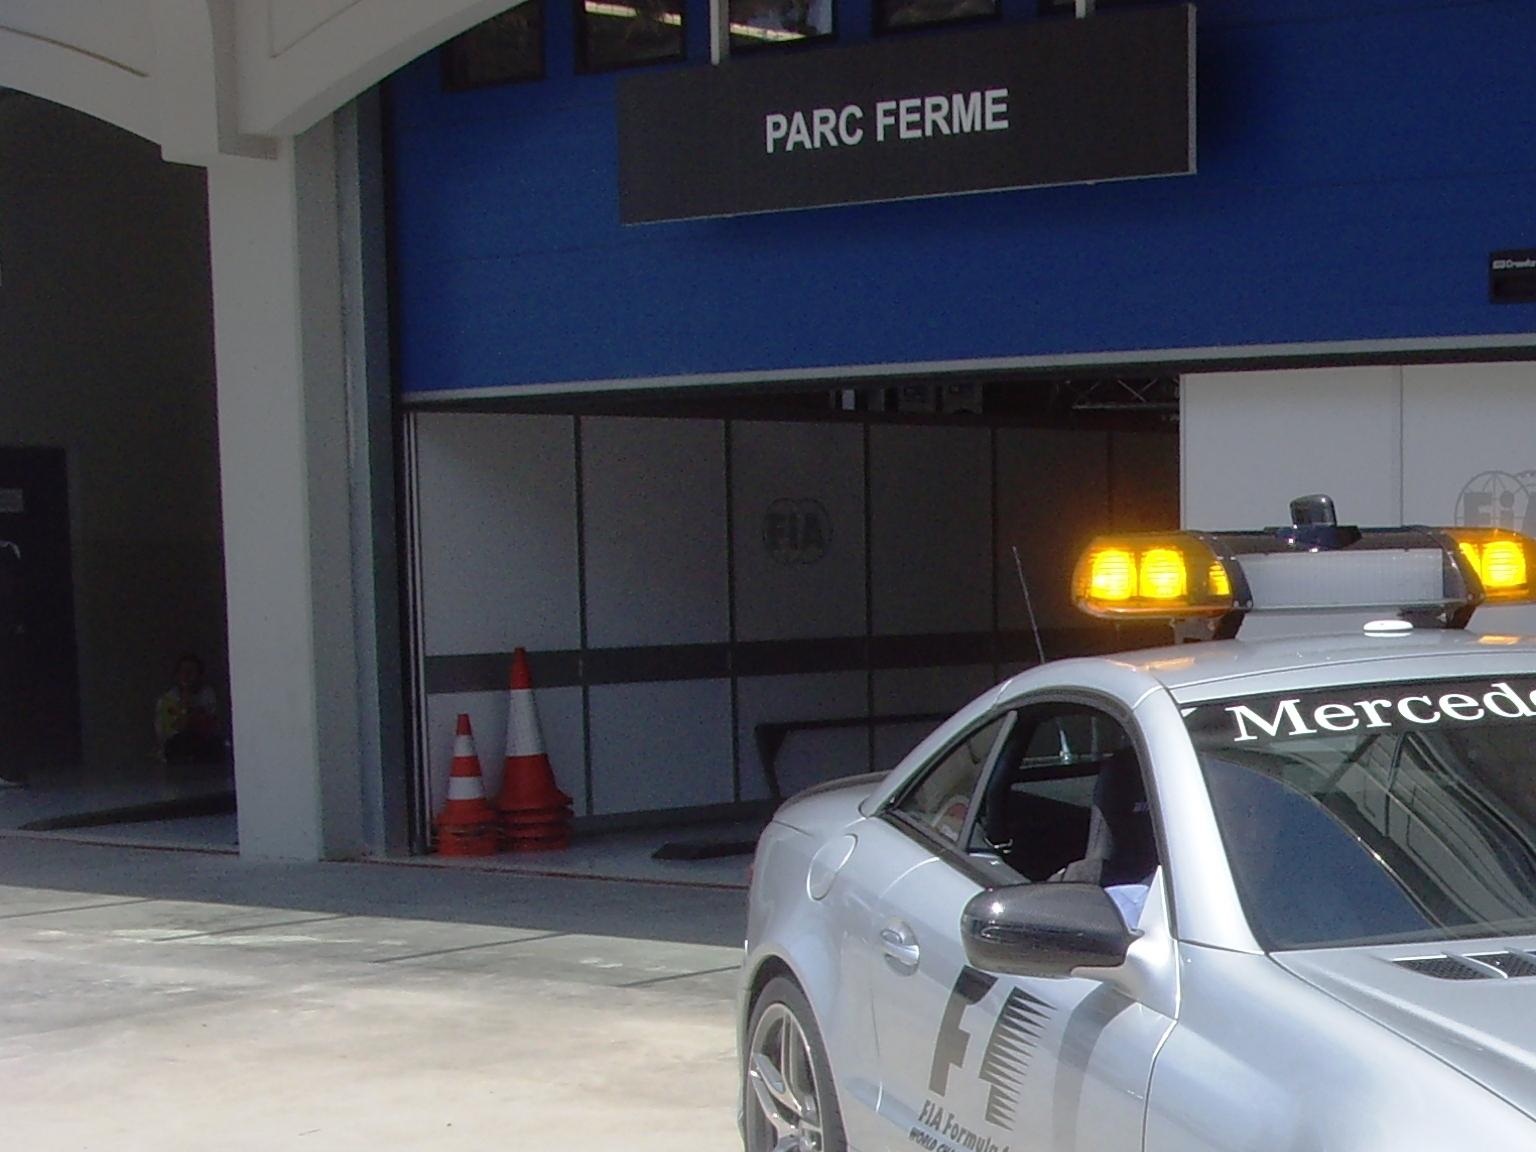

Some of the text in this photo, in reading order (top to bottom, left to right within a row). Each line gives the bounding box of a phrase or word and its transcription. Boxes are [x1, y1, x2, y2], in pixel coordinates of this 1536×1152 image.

[765, 88, 1009, 153] PARC FERME
[918, 1099, 944, 1131] FIA
